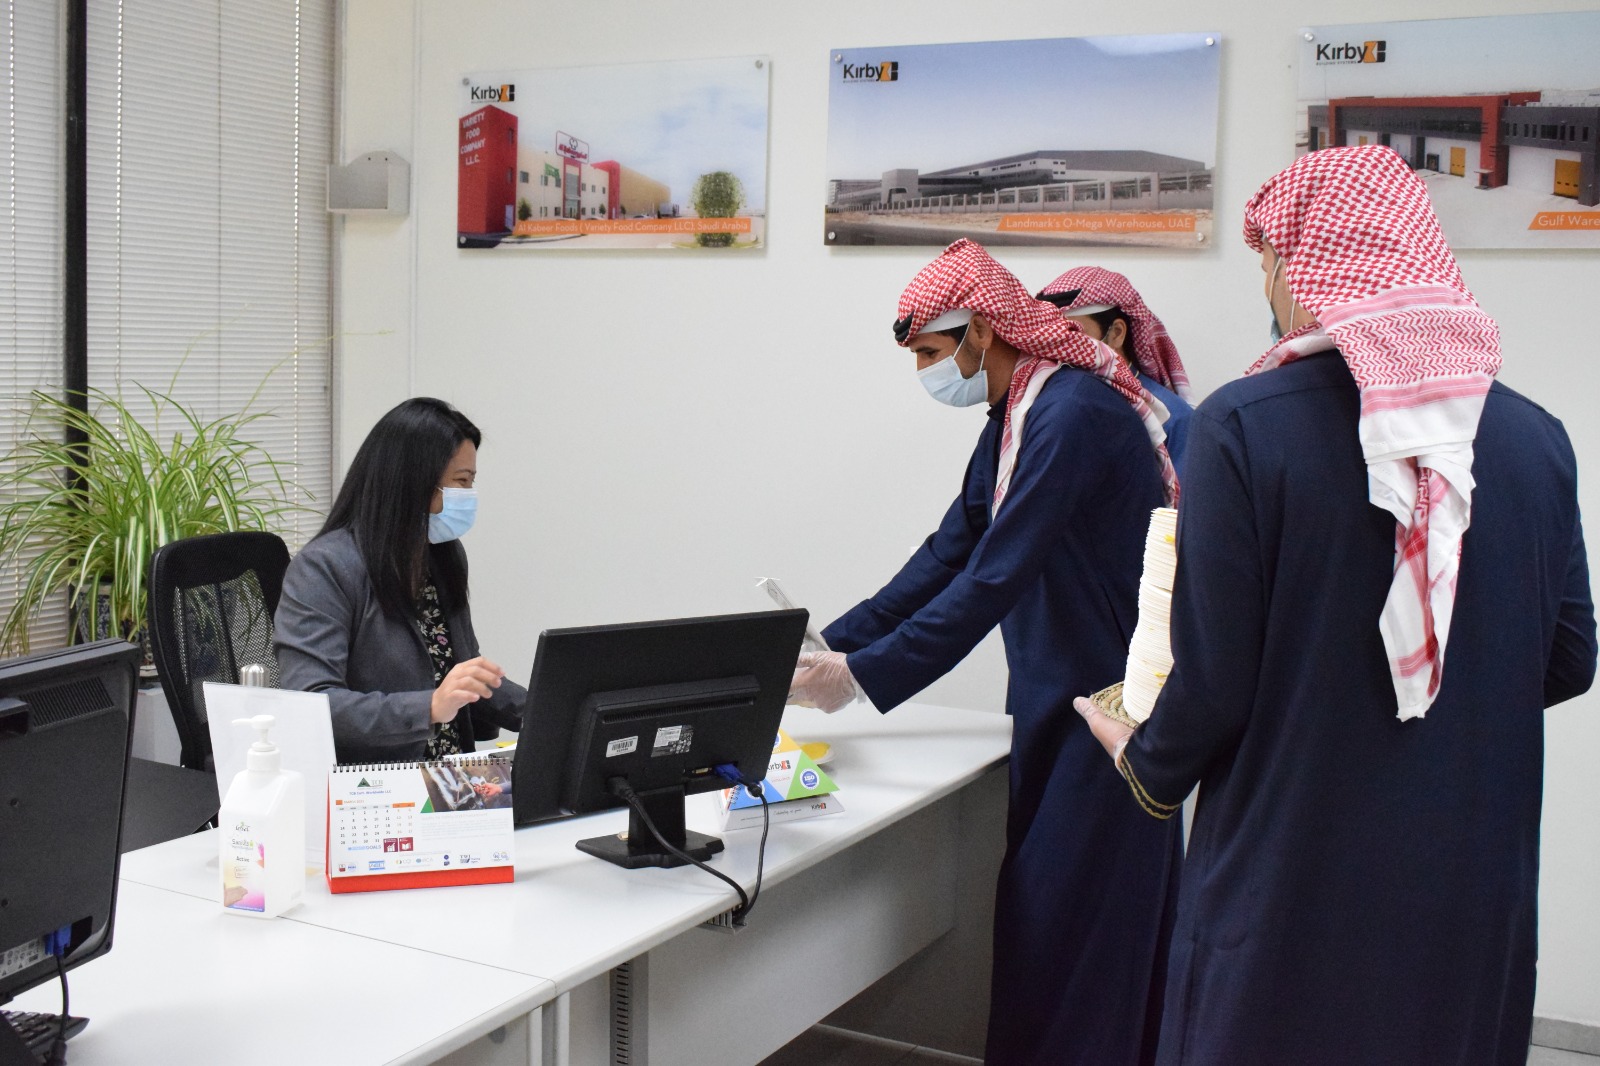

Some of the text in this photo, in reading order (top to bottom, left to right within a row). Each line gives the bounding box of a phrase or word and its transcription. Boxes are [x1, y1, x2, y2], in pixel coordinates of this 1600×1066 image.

[462, 111, 486, 129] VARIETY
[465, 127, 481, 140] FOOD
[460, 137, 486, 155] COMPANY
[1006, 218, 1061, 228] Landmark's
[1106, 217, 1165, 229] Warehouse,
[1168, 217, 1191, 228] UAE
[1538, 214, 1566, 226] Gulf
[518, 224, 526, 232] Al
[528, 223, 553, 232] Kabeer
[555, 223, 578, 232] Foods
[584, 222, 612, 233] Variety
[613, 222, 634, 231] Food
[634, 222, 672, 232] Company
[698, 221, 720, 230] Saudi
[722, 221, 748, 230] Arabia
